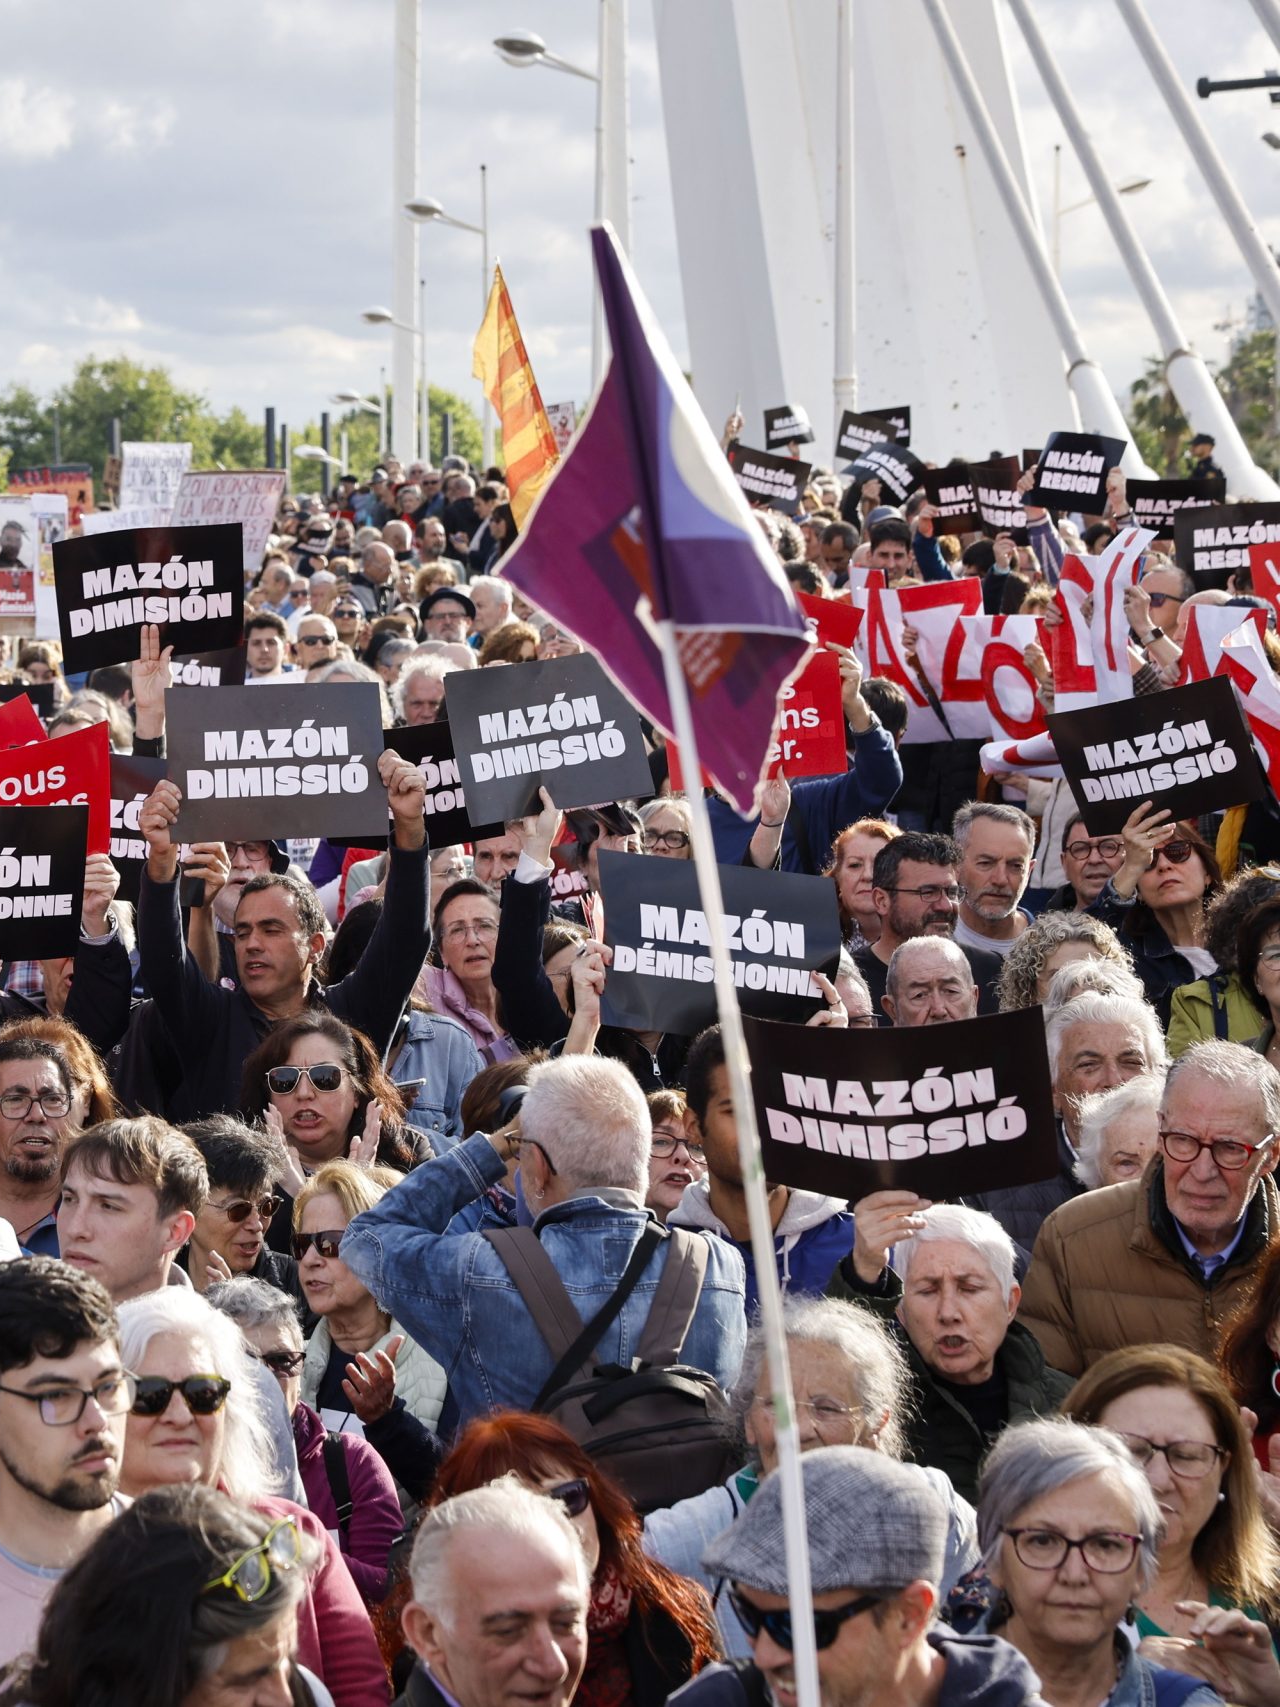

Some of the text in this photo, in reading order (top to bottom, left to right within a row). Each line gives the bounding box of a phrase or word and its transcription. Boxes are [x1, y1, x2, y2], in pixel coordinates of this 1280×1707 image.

[741, 461, 796, 487] MAZÓN
[1039, 471, 1100, 495] RESIGN
[1044, 451, 1105, 474] MAZÓN
[82, 555, 214, 599] MAZÓN
[69, 588, 232, 638] DIMISIÓN
[204, 719, 349, 762] MAZÓN
[477, 692, 602, 745] MAZÓN
[470, 719, 627, 783] DIMISSIÓ
[1082, 719, 1212, 772] MAZÓN
[186, 754, 369, 800] DIMISSIÓ
[1080, 739, 1238, 804] DIMISSIÓ
[639, 903, 806, 959] MAZÓN
[781, 1066, 997, 1117] MAZÓN
[765, 1095, 1028, 1161] DIMISSIÓ
